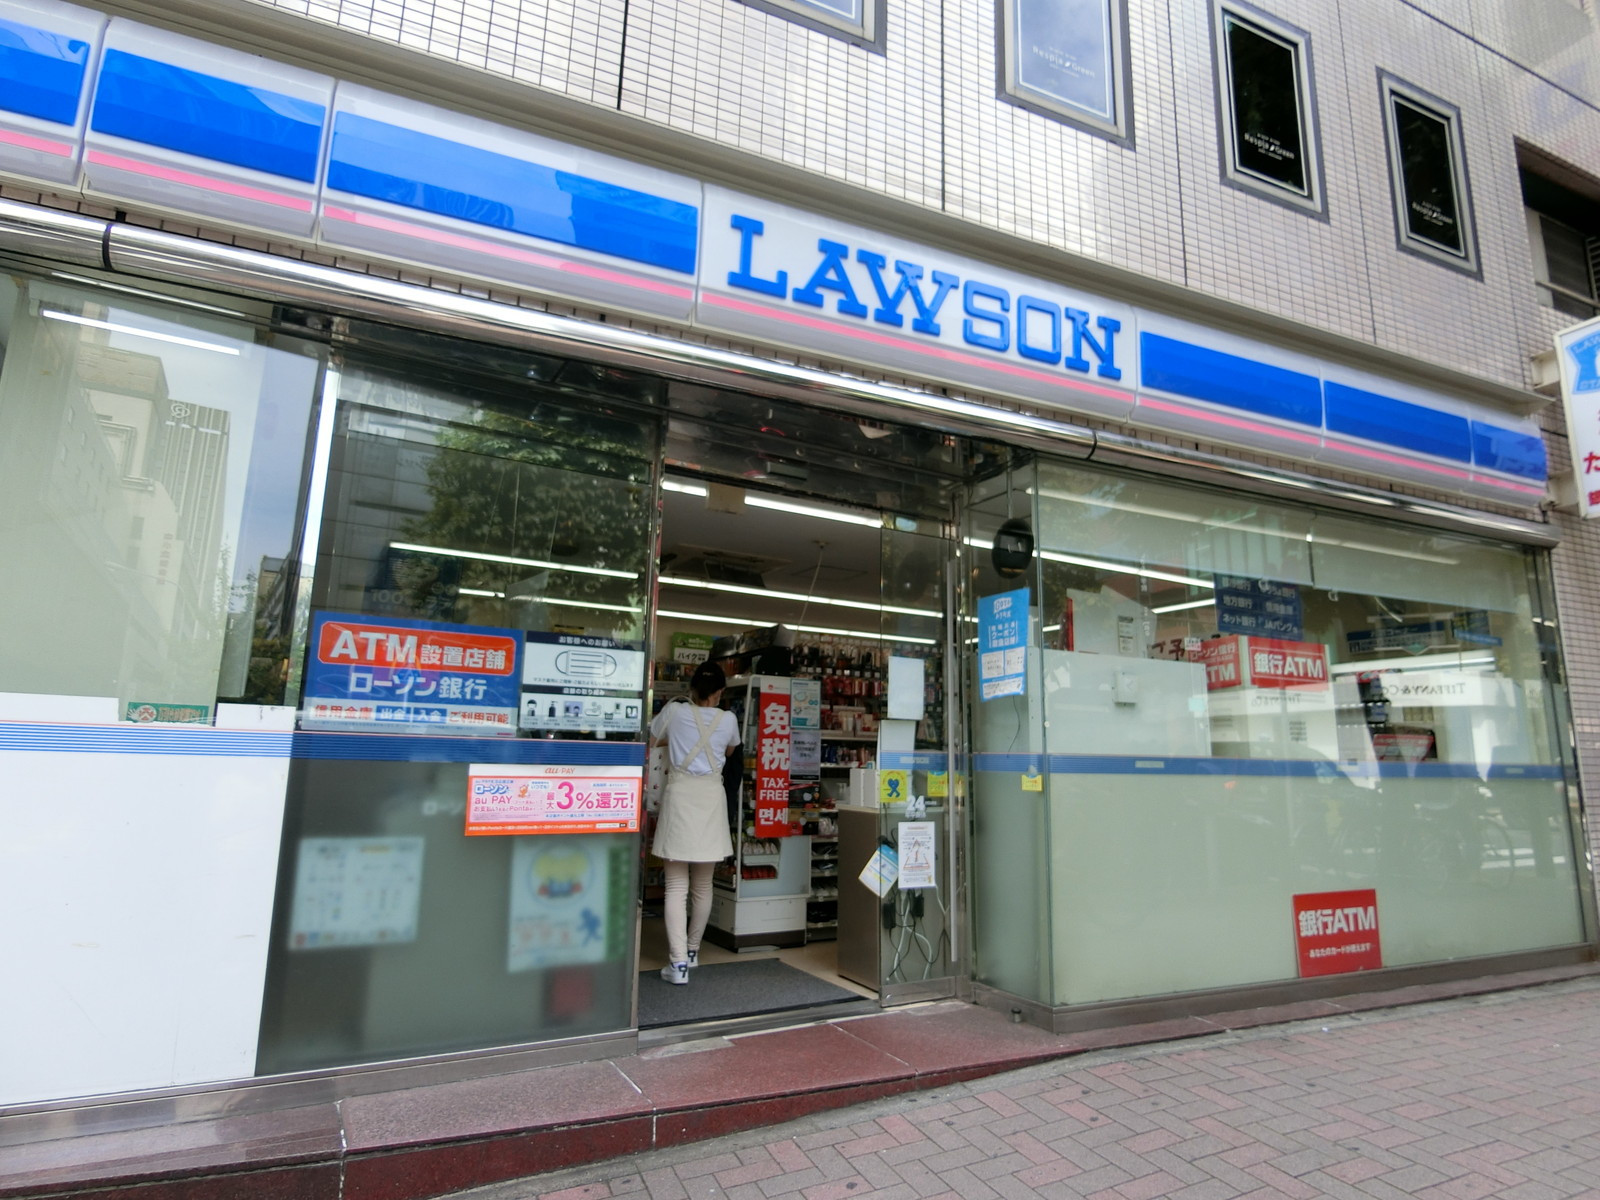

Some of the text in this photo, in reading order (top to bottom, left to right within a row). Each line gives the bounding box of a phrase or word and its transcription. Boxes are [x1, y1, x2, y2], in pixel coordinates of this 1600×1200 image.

[728, 214, 1121, 381] LAWSON
[1206, 662, 1235, 683] TM
[1254, 652, 1324, 679] 銀行ATM
[351, 672, 488, 700] ローソン銀行
[763, 702, 790, 770] 免税
[561, 767, 576, 775] PAY
[762, 777, 788, 788] TAX-
[491, 795, 513, 805] PAY
[760, 789, 789, 801] FREE
[907, 796, 925, 809] 24
[758, 807, 788, 825] 면세
[1299, 906, 1376, 937] 銀行ATM
